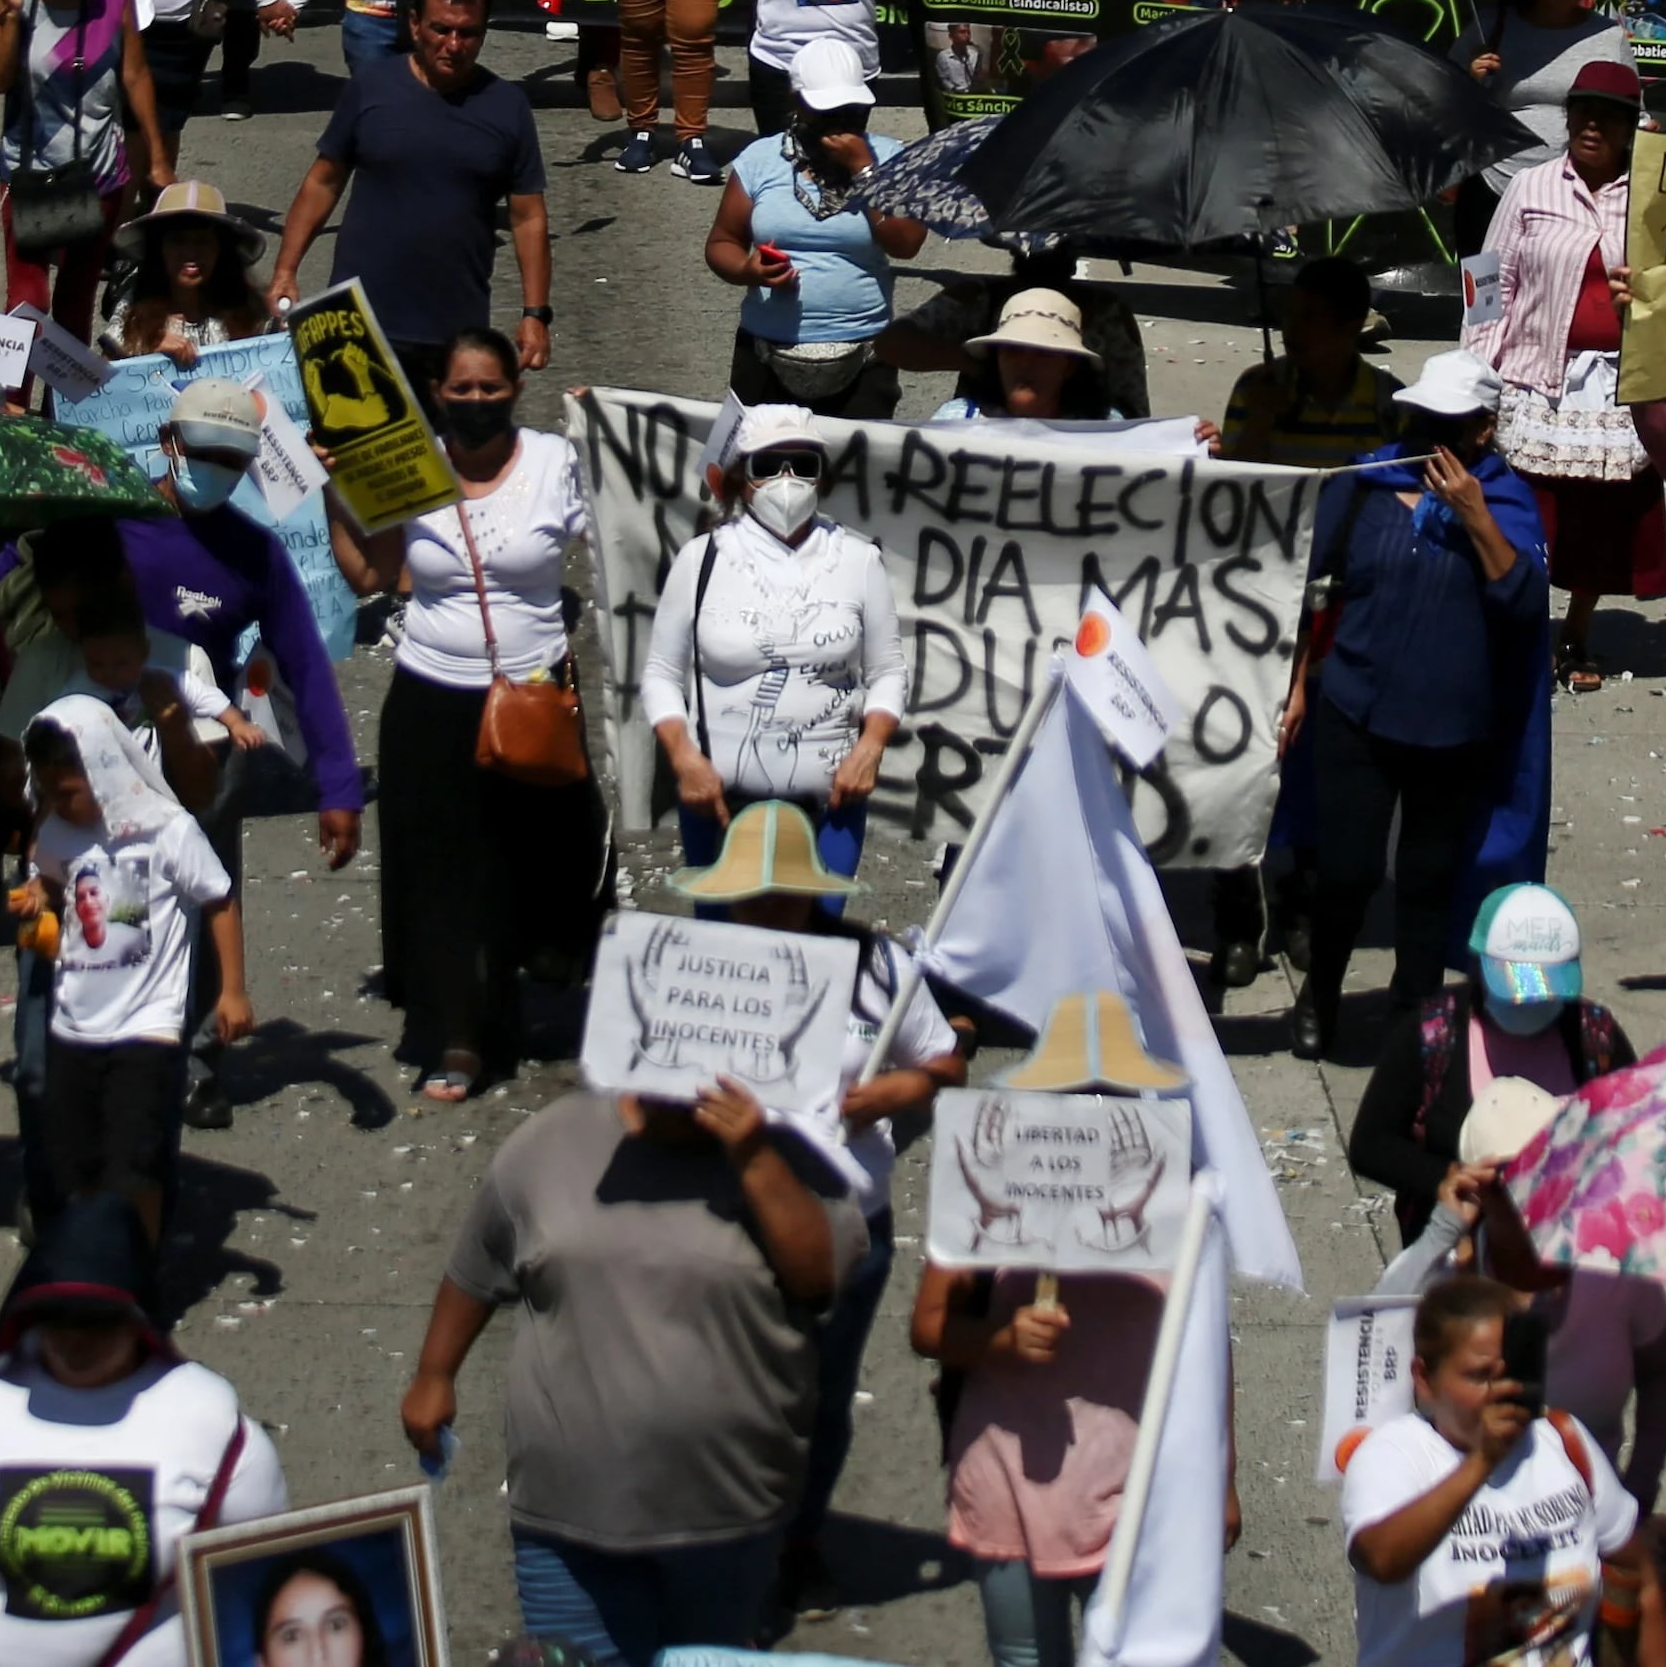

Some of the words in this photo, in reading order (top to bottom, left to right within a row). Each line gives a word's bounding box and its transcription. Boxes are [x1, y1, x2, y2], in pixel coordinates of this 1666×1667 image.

[39, 335, 102, 387] RESISTENCIA
[261, 425, 309, 495] RESISTENCIA
[580, 393, 688, 501] NO
[260, 459, 280, 485] BRP
[914, 535, 1041, 635] DIA
[813, 625, 856, 648] our
[1107, 649, 1168, 735] RESISTENCIA
[677, 953, 771, 983] JUSTICIA
[666, 985, 726, 1012] PARA
[733, 996, 774, 1018] LOS
[652, 1018, 776, 1051] INOCENTES
[1015, 1125, 1101, 1144] LIBERTAD
[1030, 1154, 1044, 1172] A
[1048, 1154, 1082, 1172] LOS
[1004, 1181, 1105, 1201] INOCENTES
[1355, 1307, 1375, 1421] RESISTENCIA
[1384, 1344, 1398, 1382] BRP
[14, 1524, 132, 1558] MOVIR
